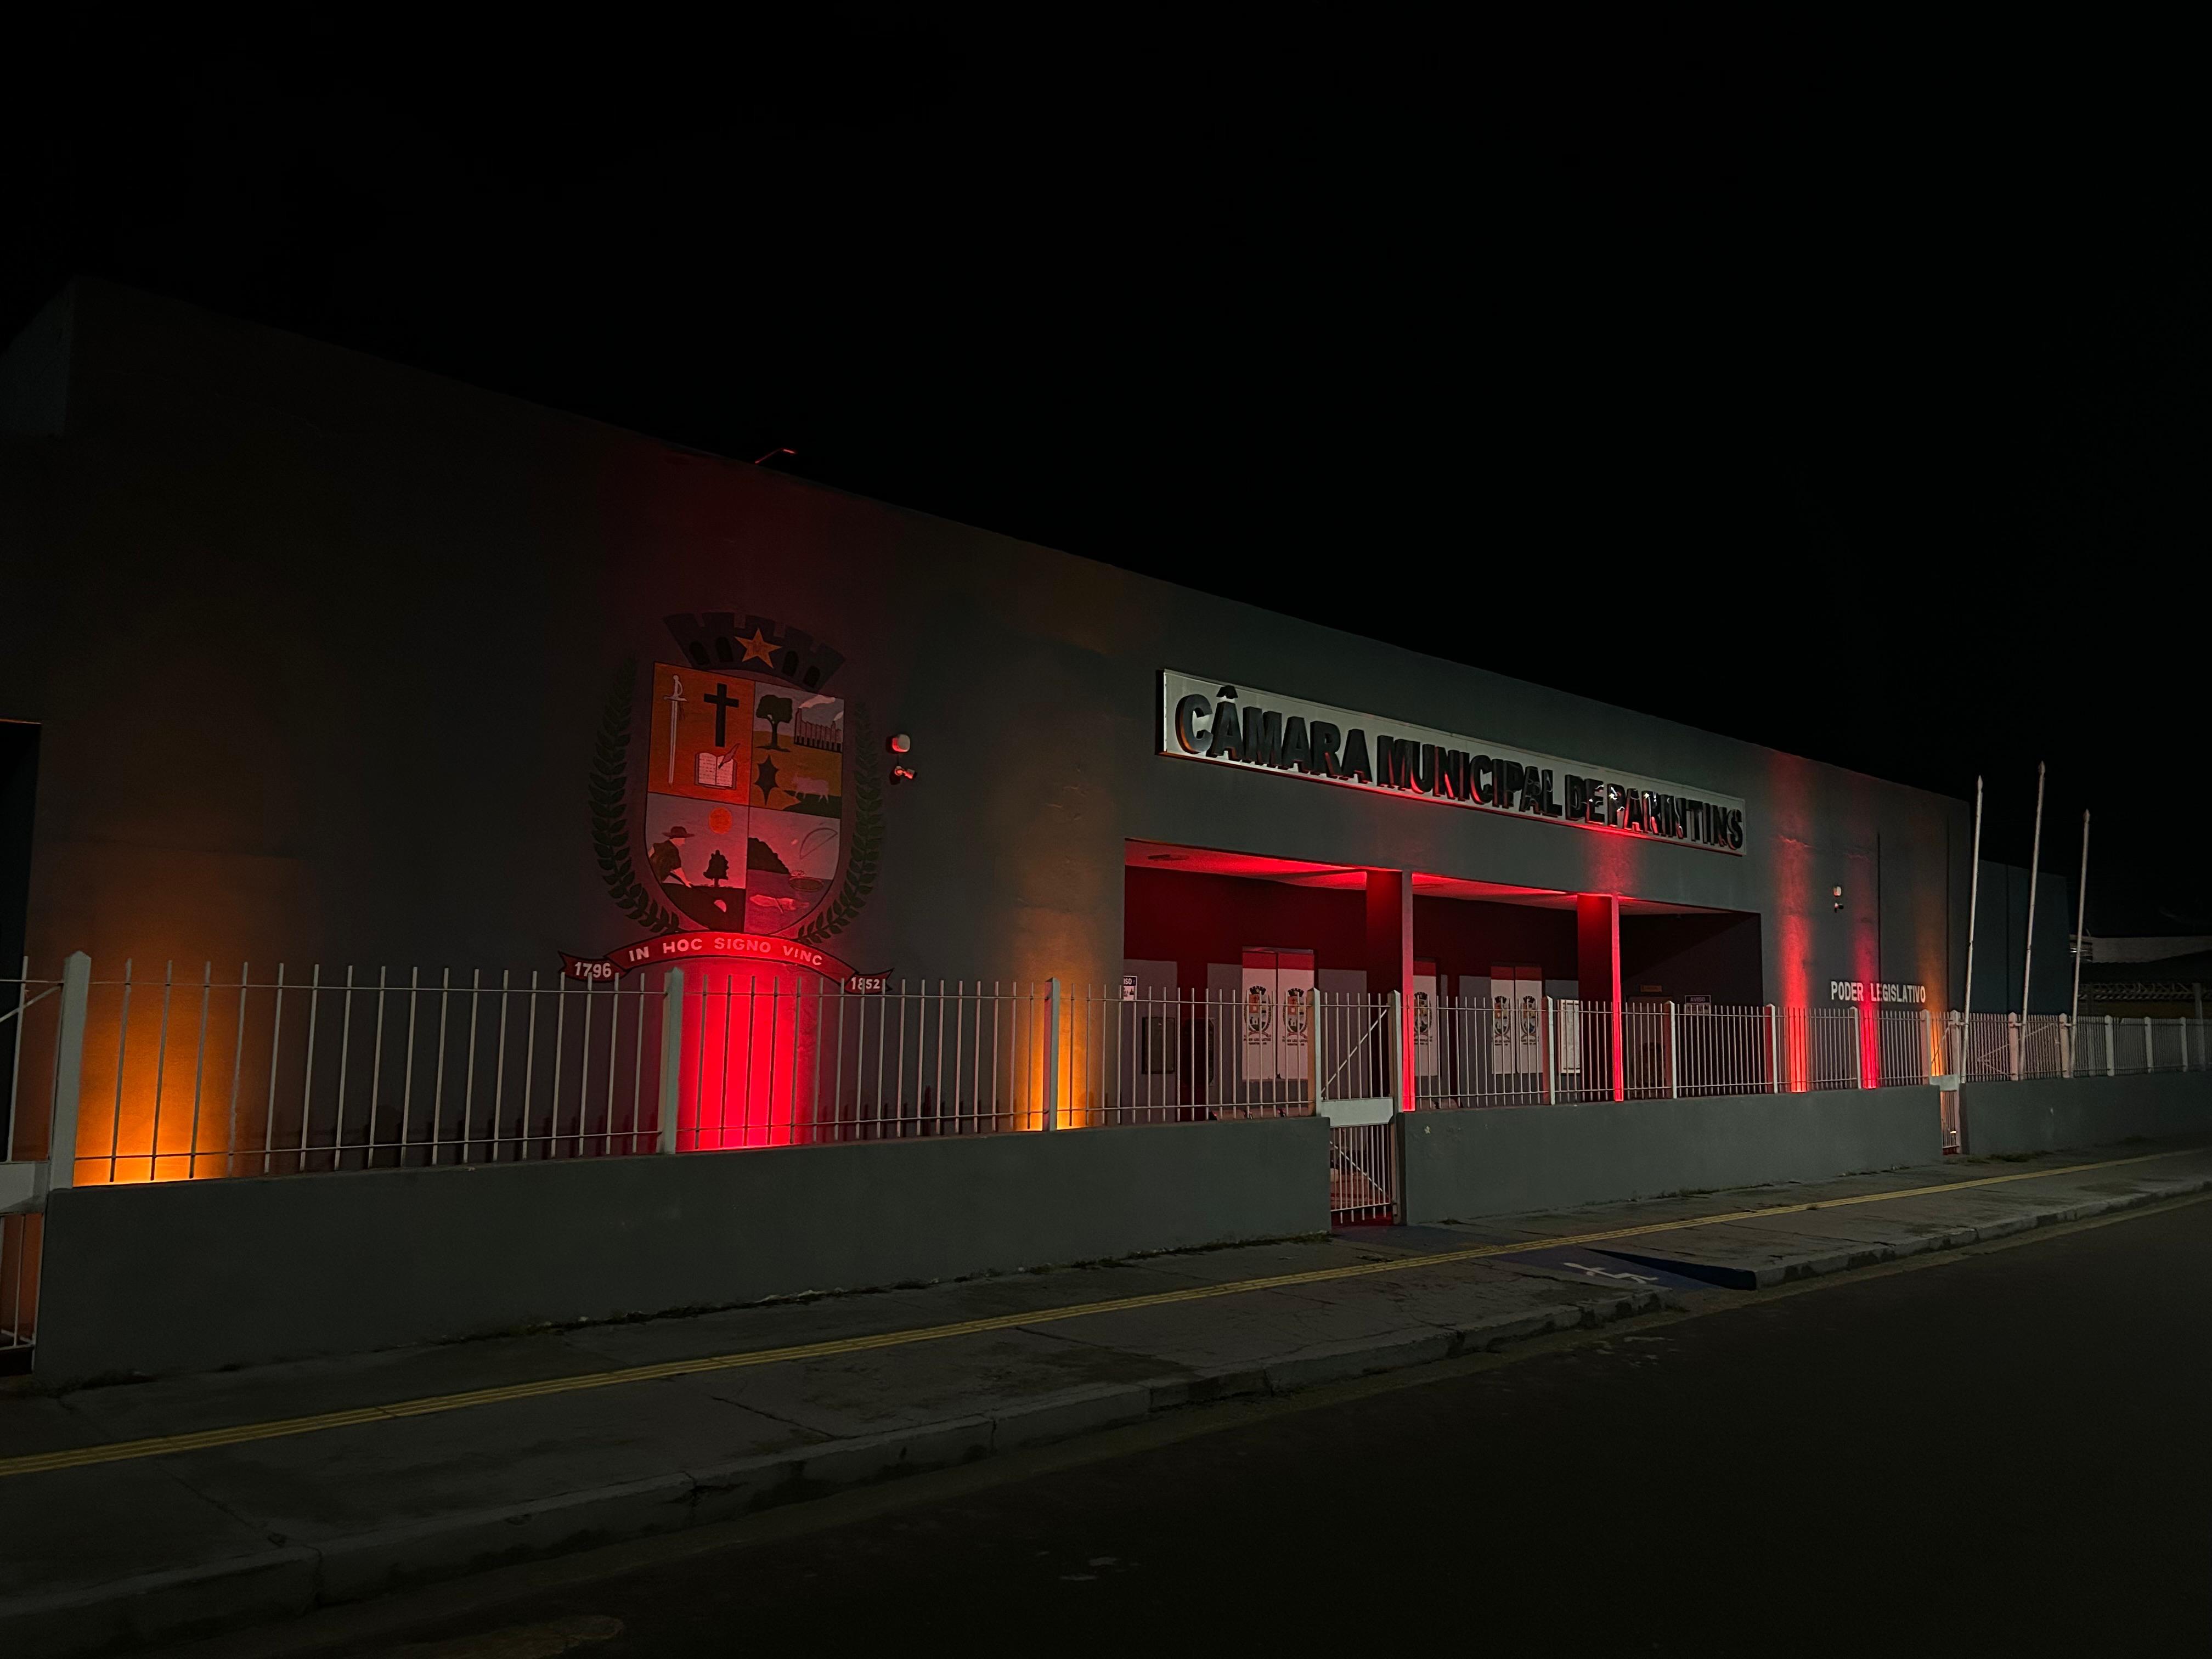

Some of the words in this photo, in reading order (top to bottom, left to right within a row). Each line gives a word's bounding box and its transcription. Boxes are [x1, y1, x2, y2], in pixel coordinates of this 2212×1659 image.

[1176, 685, 1372, 783] CÂMARA
[1377, 735, 1562, 817] MUNICIPAL
[1565, 774, 1605, 825] DE
[1607, 783, 1742, 850] PARINTINS
[629, 946, 650, 962] IN
[663, 938, 702, 953] HOC
[714, 937, 771, 953] SIGNO
[782, 945, 823, 966] VINC
[574, 961, 612, 978] 1796
[1831, 980, 1864, 1001] PODER
[1870, 983, 1926, 1003] LEGISLATIVO
